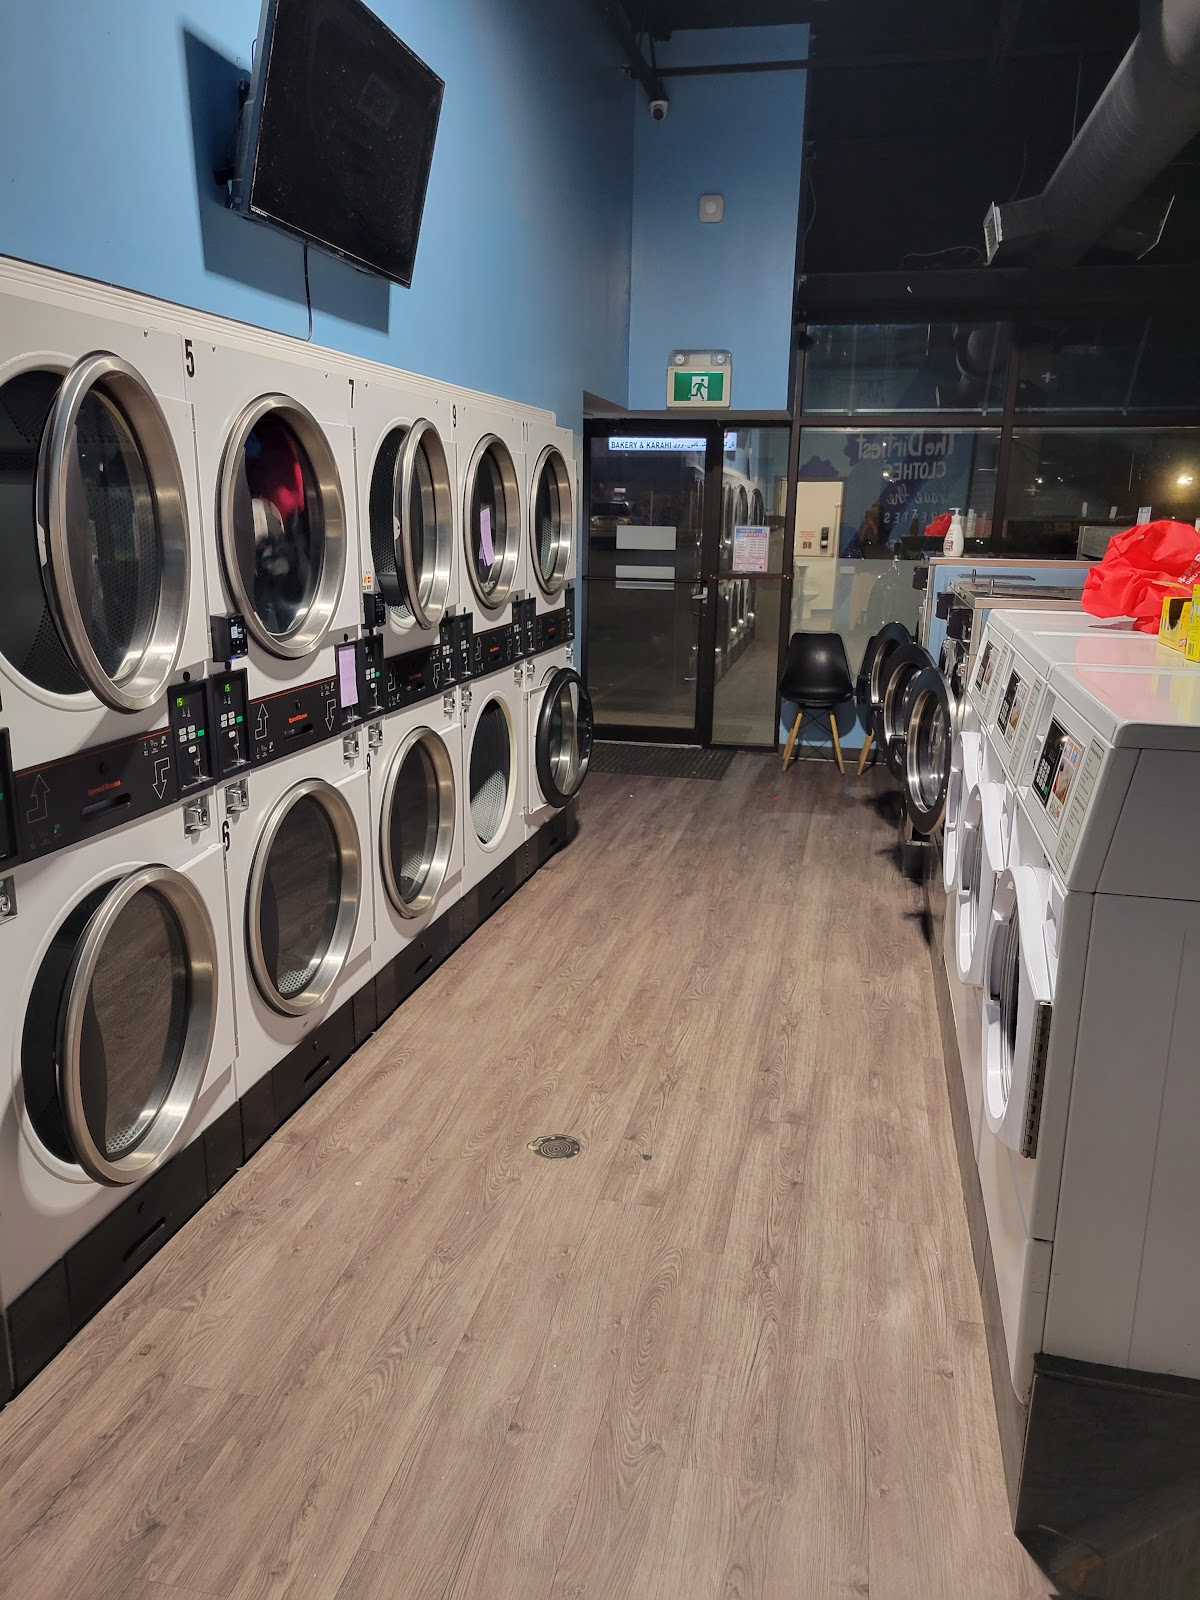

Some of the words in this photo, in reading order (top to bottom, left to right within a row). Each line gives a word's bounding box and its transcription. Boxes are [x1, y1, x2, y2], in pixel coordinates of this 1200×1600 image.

[185, 338, 195, 378] 5
[348, 378, 354, 408] 7
[452, 404, 457, 428] 9
[611, 441, 638, 449] BAKERY
[639, 441, 644, 449] &
[646, 441, 672, 449] KARAHI
